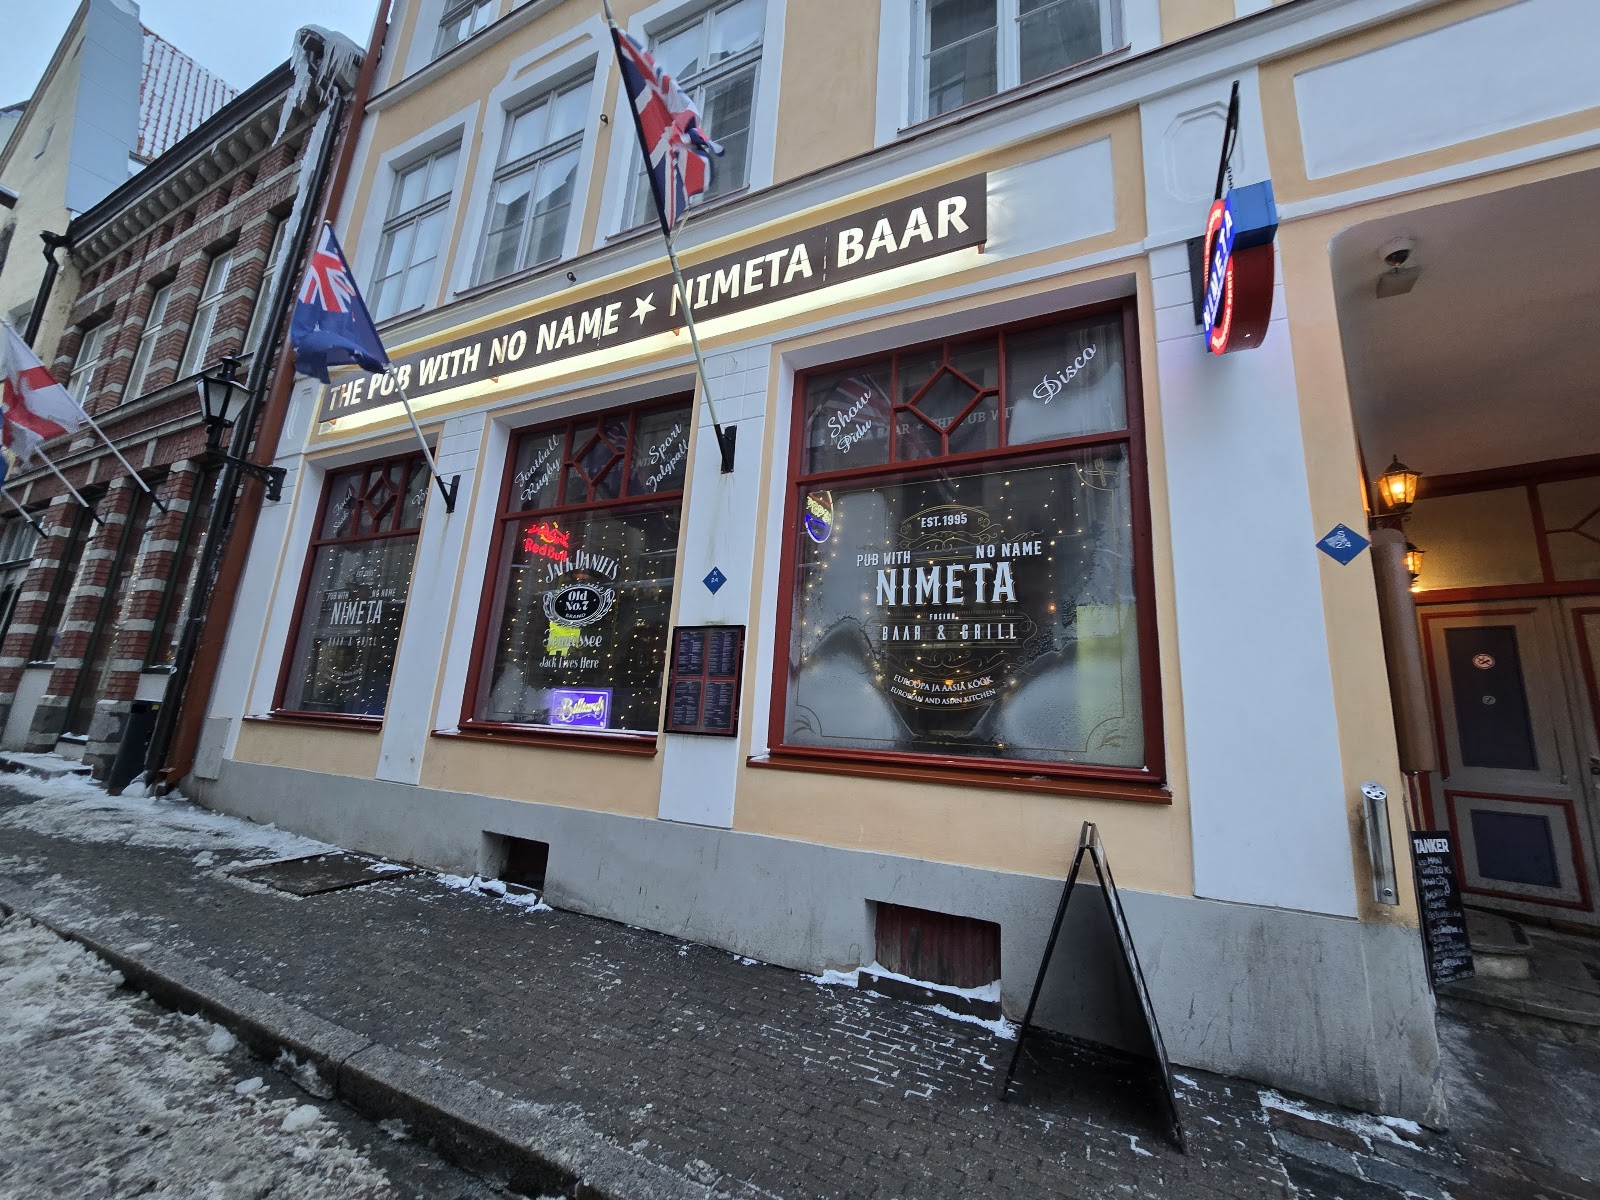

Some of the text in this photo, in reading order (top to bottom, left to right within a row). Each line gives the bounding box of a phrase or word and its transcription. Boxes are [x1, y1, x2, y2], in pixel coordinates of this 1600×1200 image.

[329, 195, 969, 411] THE PUB WITH NO NAME NIMETA BAAR
[1032, 343, 1097, 405] Disco
[827, 389, 872, 438] Show
[649, 423, 682, 465] Sport
[836, 419, 873, 454] Pidu
[514, 434, 560, 487] Football
[520, 457, 561, 501] Rugby
[856, 540, 1042, 567] PUB WITH NO NAME
[1335, 541, 1352, 549] 24
[568, 591, 588, 601] Old
[875, 561, 1018, 607] NIMETA
[330, 600, 383, 625] NIMETA
[929, 612, 956, 620] FUSION
[882, 622, 1016, 641] BAAR & GRILL
[539, 656, 557, 668] Jack
[580, 656, 599, 668] Here
[890, 686, 996, 705] EUROPEAN AND ASIAN KITCHEN
[893, 674, 930, 691] EUROOPA
[931, 684, 940, 692] JA
[941, 682, 966, 692] AASIA
[1414, 838, 1449, 854] TANKER
